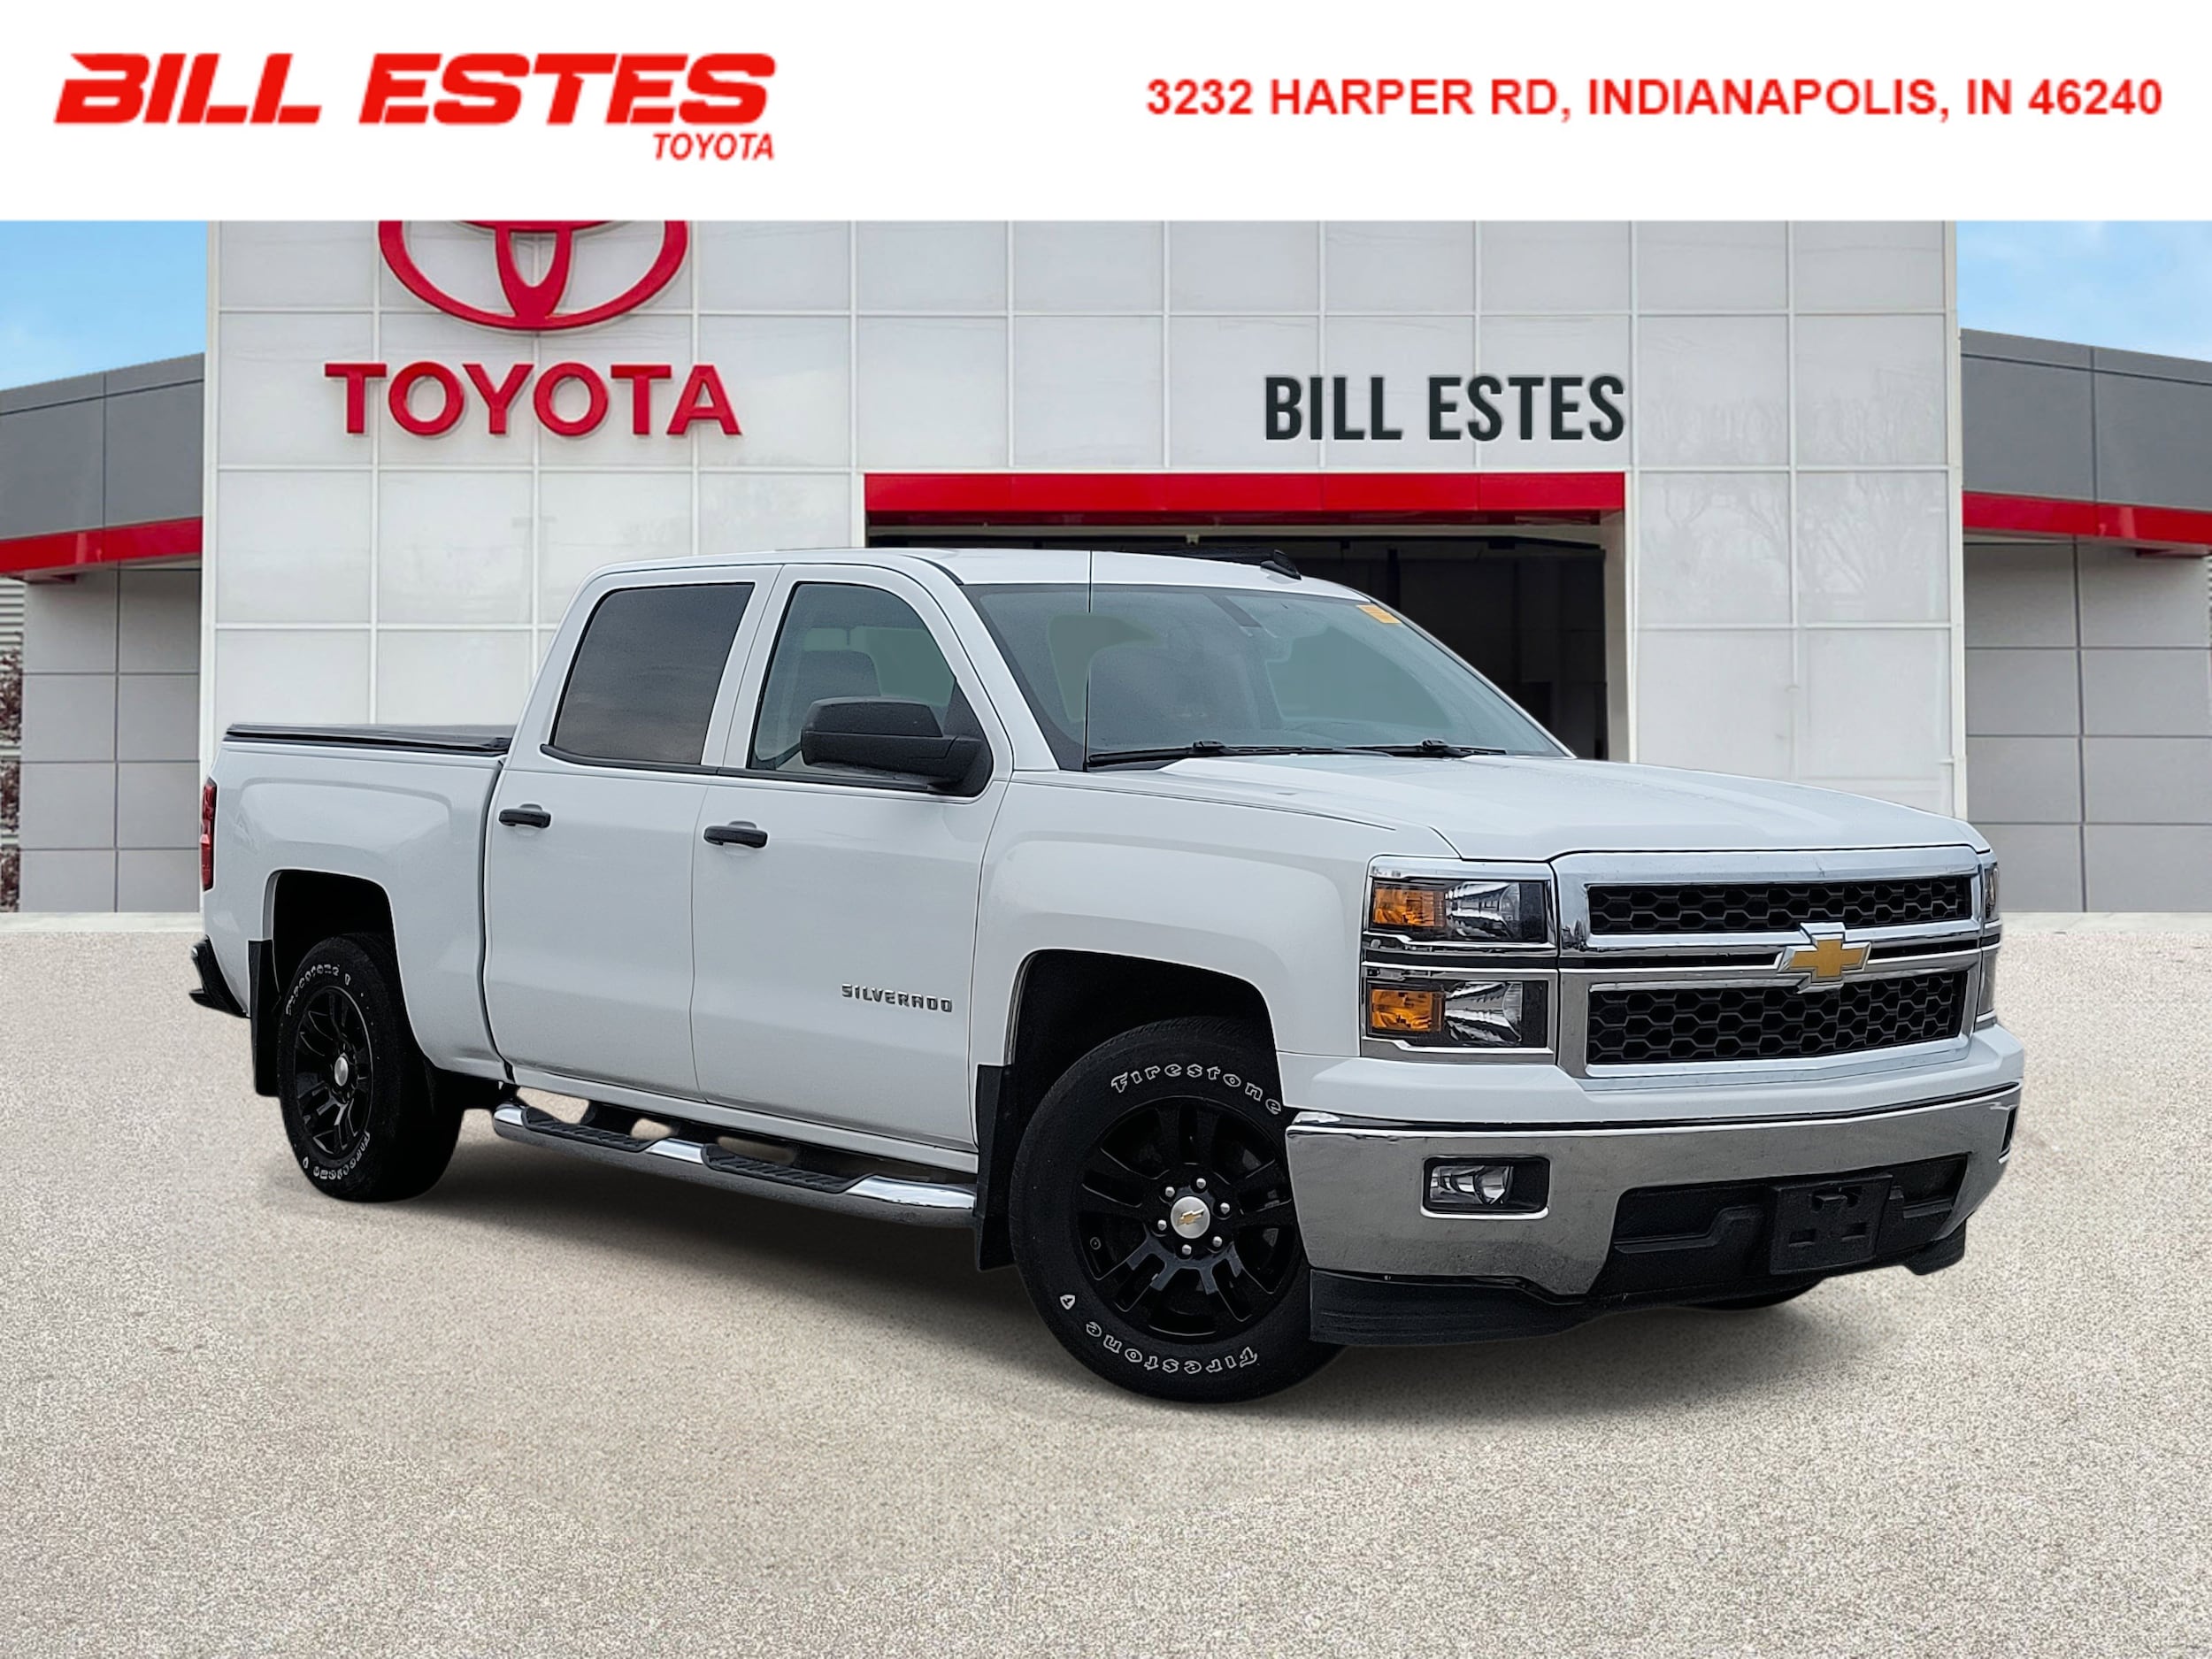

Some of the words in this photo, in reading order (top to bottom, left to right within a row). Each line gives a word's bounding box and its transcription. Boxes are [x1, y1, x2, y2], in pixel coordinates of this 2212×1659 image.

[326, 361, 741, 436] TOYOTA
[1266, 376, 1402, 441] BILL
[1429, 375, 1624, 442] ESTES
[841, 983, 953, 1013] SILVERADO
[1111, 1063, 1281, 1115] Firestone
[1086, 1321, 1258, 1375] Firestone
